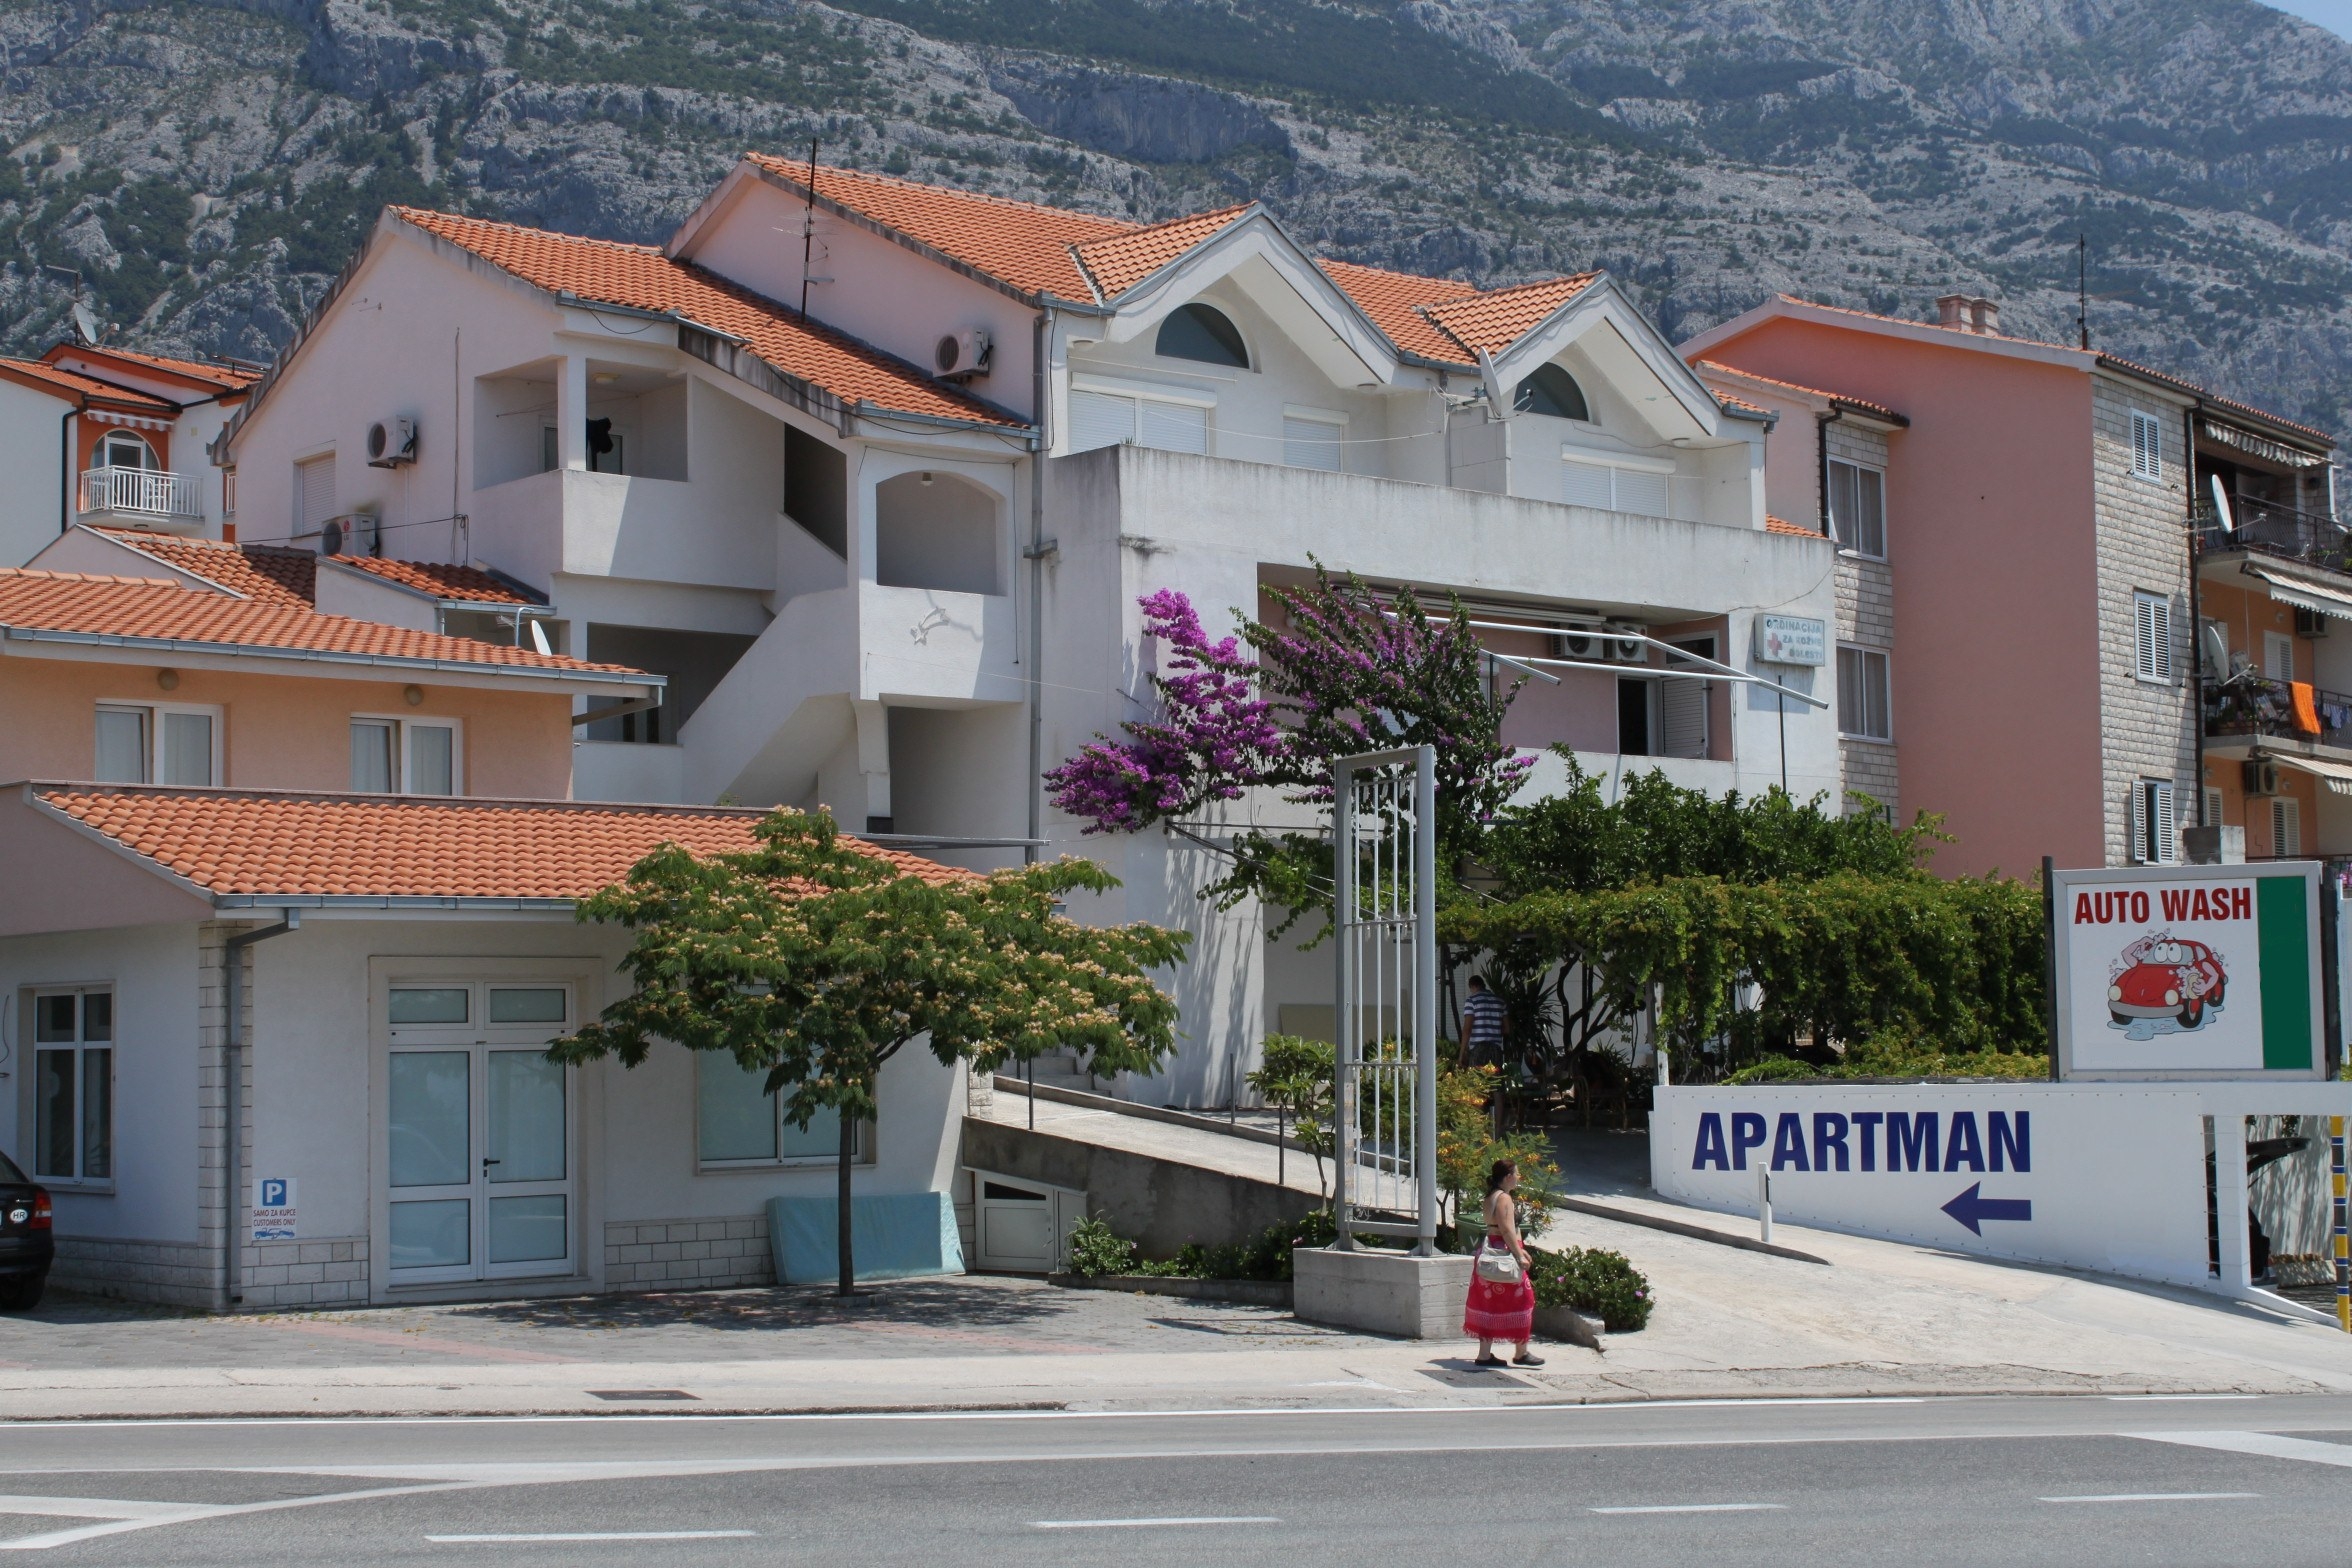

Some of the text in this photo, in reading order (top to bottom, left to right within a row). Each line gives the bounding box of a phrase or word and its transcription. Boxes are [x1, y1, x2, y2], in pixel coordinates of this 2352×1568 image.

[1766, 618, 1821, 634] ORDINACIJA
[1782, 634, 1793, 644] ZA
[2074, 887, 2252, 924] AUTO WASH
[1692, 1111, 2031, 1173] APARTMAN
[266, 1183, 283, 1203] P
[13, 1211, 26, 1219] HR
[253, 1208, 296, 1217] SAMO ZA KUPCE
[253, 1218, 296, 1227] CUSTOMERS ONLY
